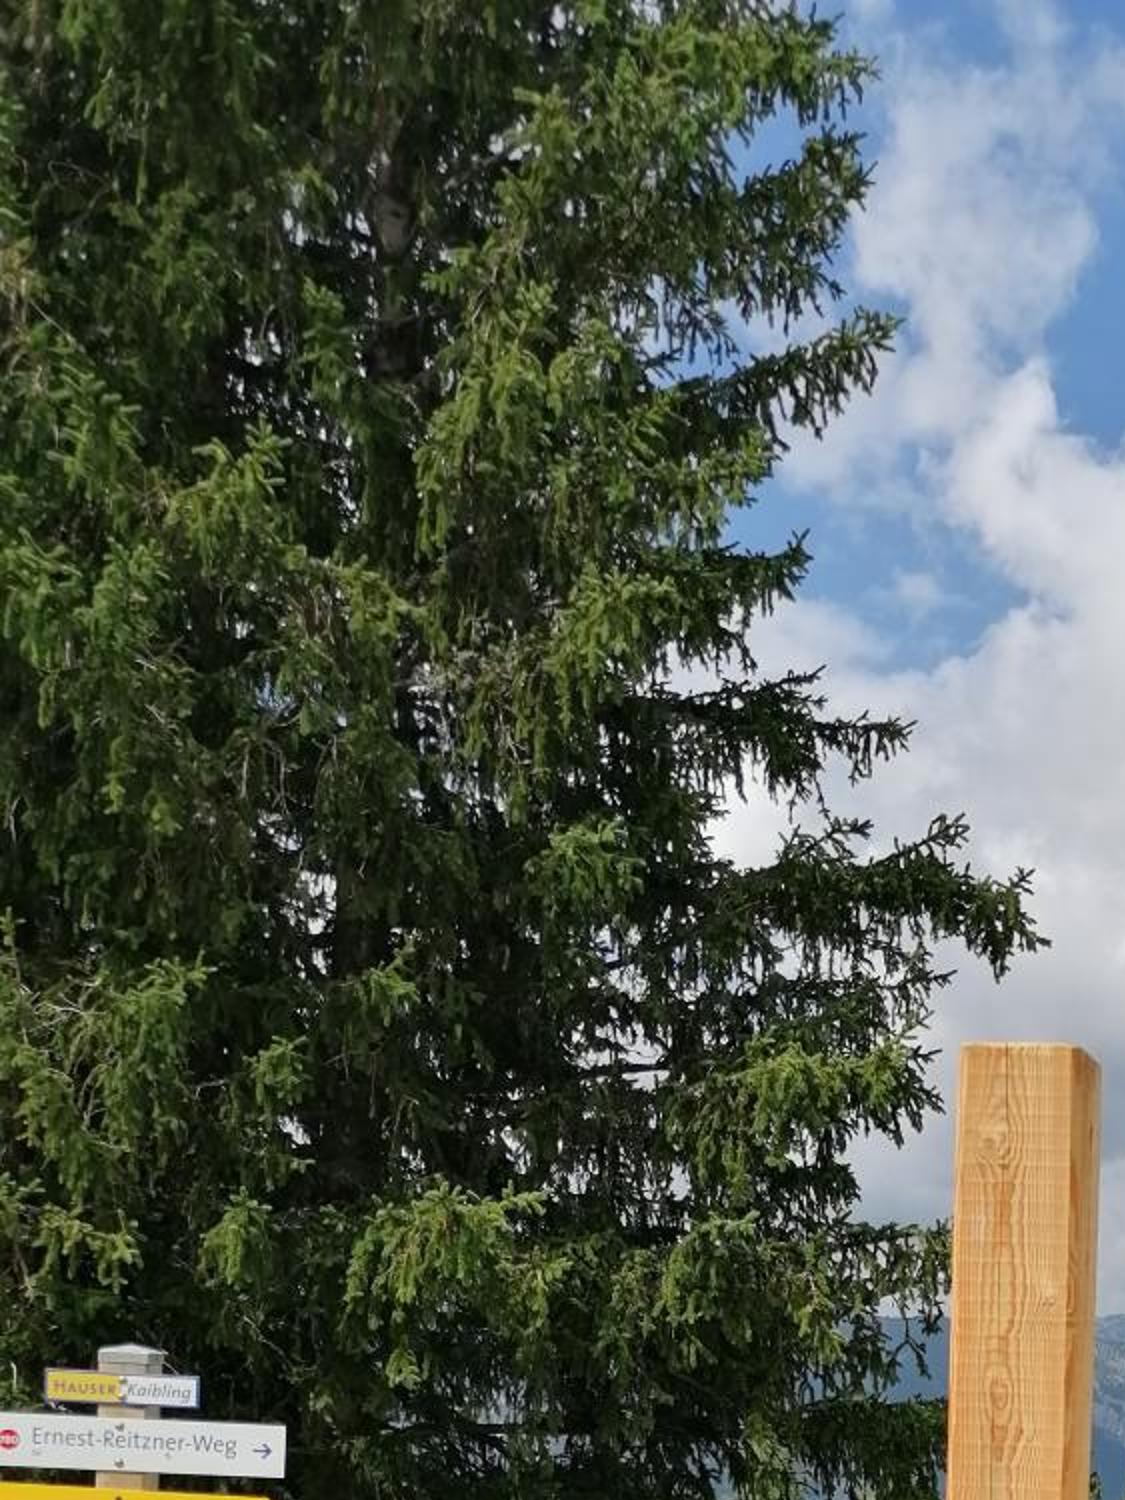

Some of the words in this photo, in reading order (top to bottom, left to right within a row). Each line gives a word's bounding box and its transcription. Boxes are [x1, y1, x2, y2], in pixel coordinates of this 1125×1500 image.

[53, 1379, 117, 1395] HAUSER
[126, 1383, 193, 1402] Kaibling
[31, 1426, 238, 1460] Ernest-Reitzner-Weg
